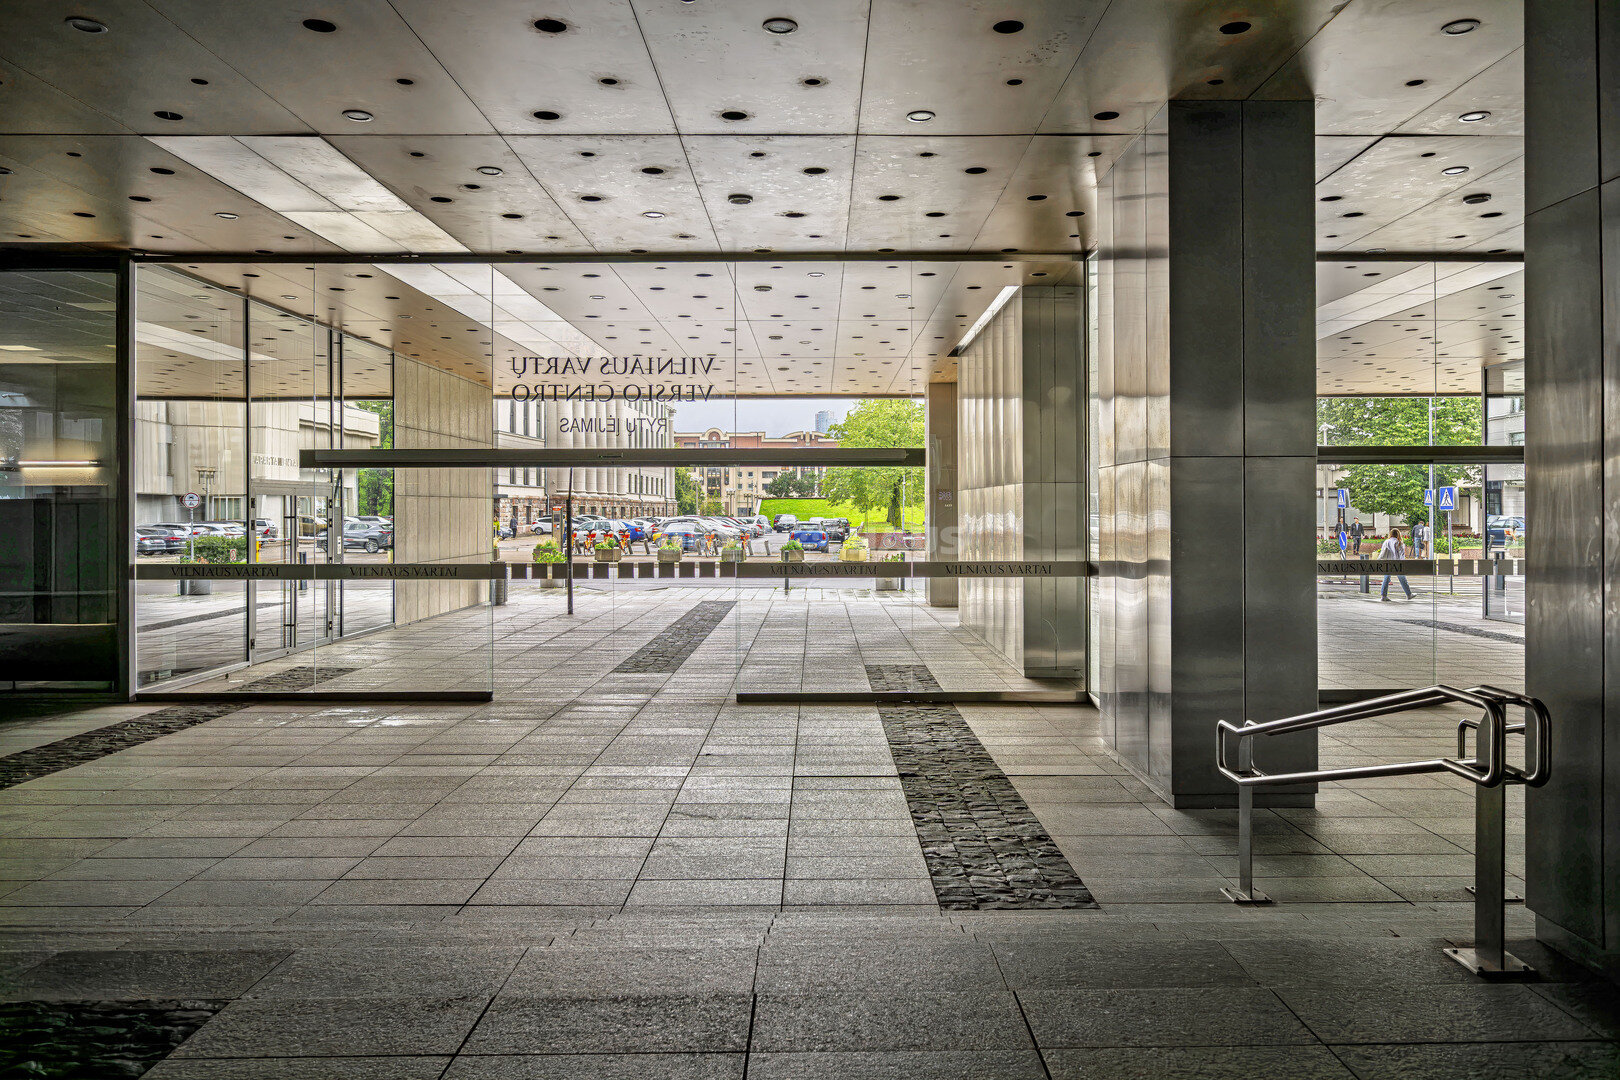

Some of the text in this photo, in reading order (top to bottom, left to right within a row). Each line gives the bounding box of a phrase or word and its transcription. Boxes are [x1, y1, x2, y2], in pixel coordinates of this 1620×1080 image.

[171, 566, 280, 577] VILNIAUS VARTAI
[349, 566, 458, 577] VILNIAUS VARTAI
[770, 565, 830, 575] VILNIAUS
[945, 564, 1052, 575] VILNIAUS VARTAI
[1318, 563, 1403, 573] NIAUS VARTAI
